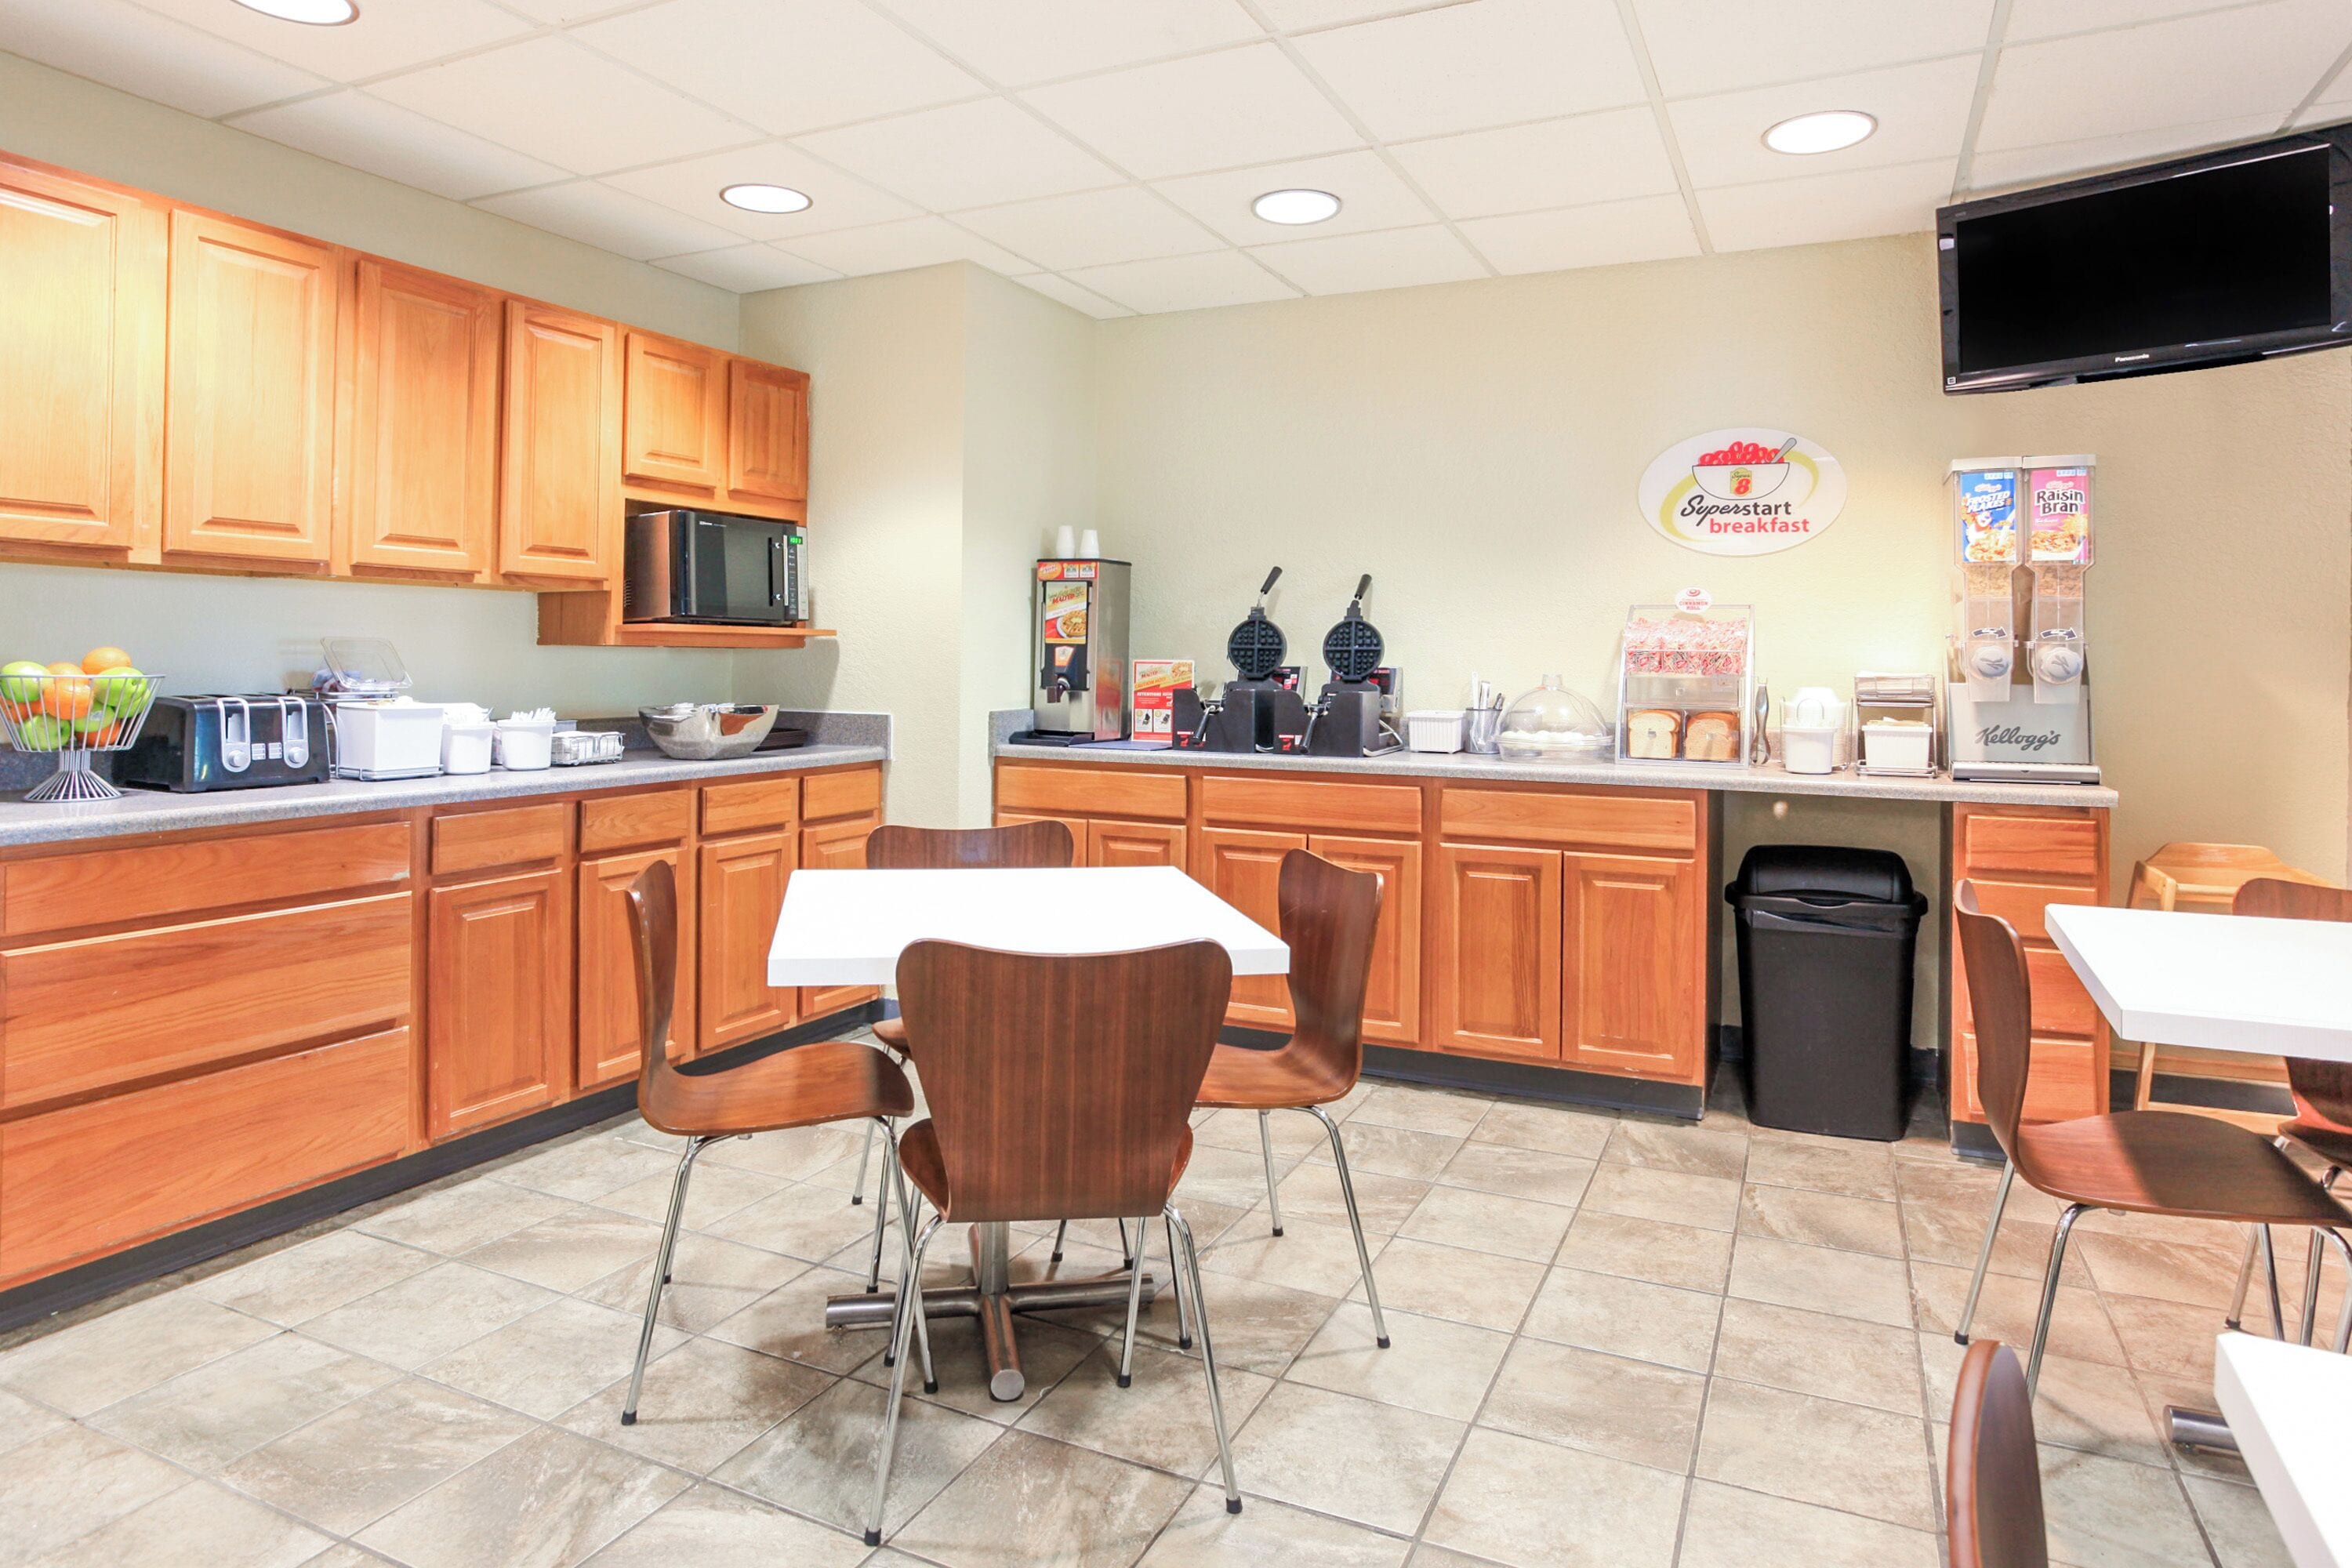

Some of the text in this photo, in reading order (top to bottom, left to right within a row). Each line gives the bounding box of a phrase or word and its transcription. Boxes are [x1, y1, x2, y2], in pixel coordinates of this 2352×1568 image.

[1734, 477, 1751, 495] 8
[1967, 491, 2010, 506] FROSTED
[2036, 490, 2084, 504] Raisin
[1680, 494, 1791, 527] Superstart
[2042, 502, 2079, 514] Bran
[1709, 517, 1809, 534] breakfast
[1974, 724, 2062, 751] Kellogg's
